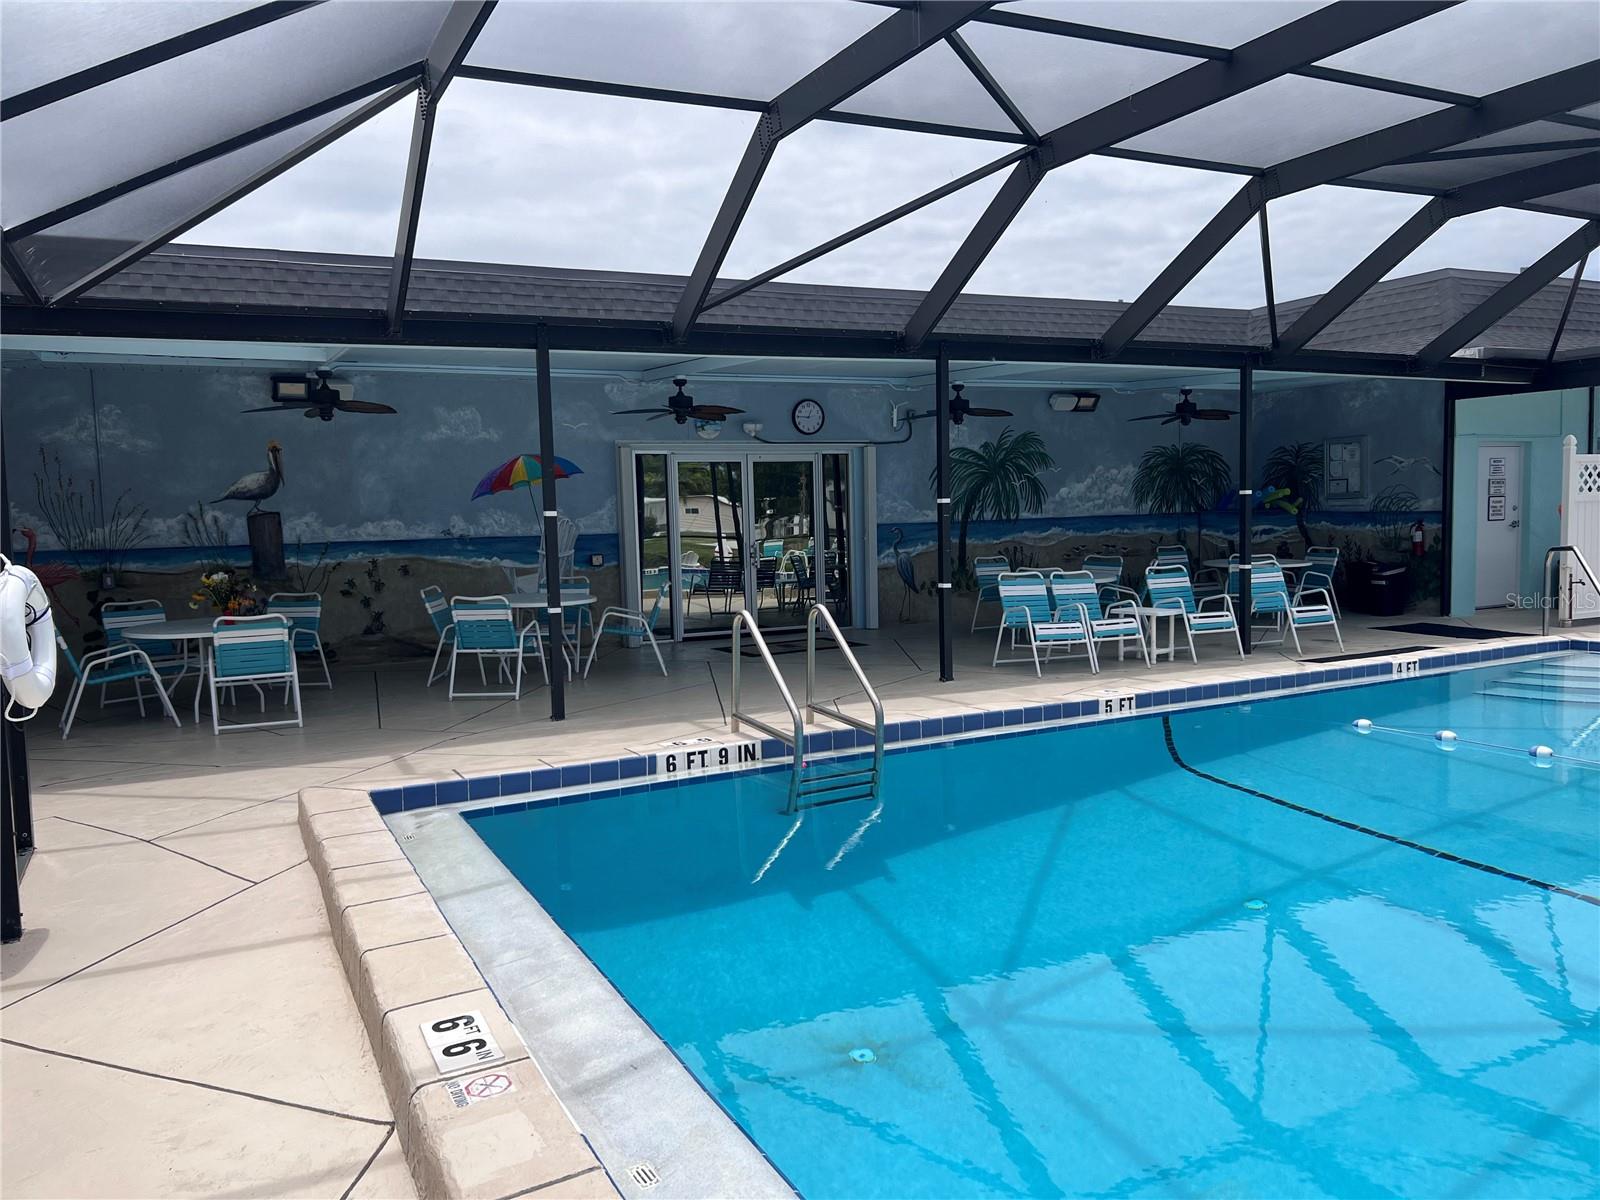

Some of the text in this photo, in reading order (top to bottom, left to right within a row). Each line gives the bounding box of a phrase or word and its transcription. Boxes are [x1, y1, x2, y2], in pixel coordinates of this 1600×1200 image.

[1396, 660, 1418, 673] 4 FT
[1105, 696, 1134, 713] 5 FT
[665, 754, 677, 773] 6
[718, 747, 729, 766] 9
[431, 1015, 482, 1035] 6 FT
[442, 1038, 495, 1061] 6 IN
